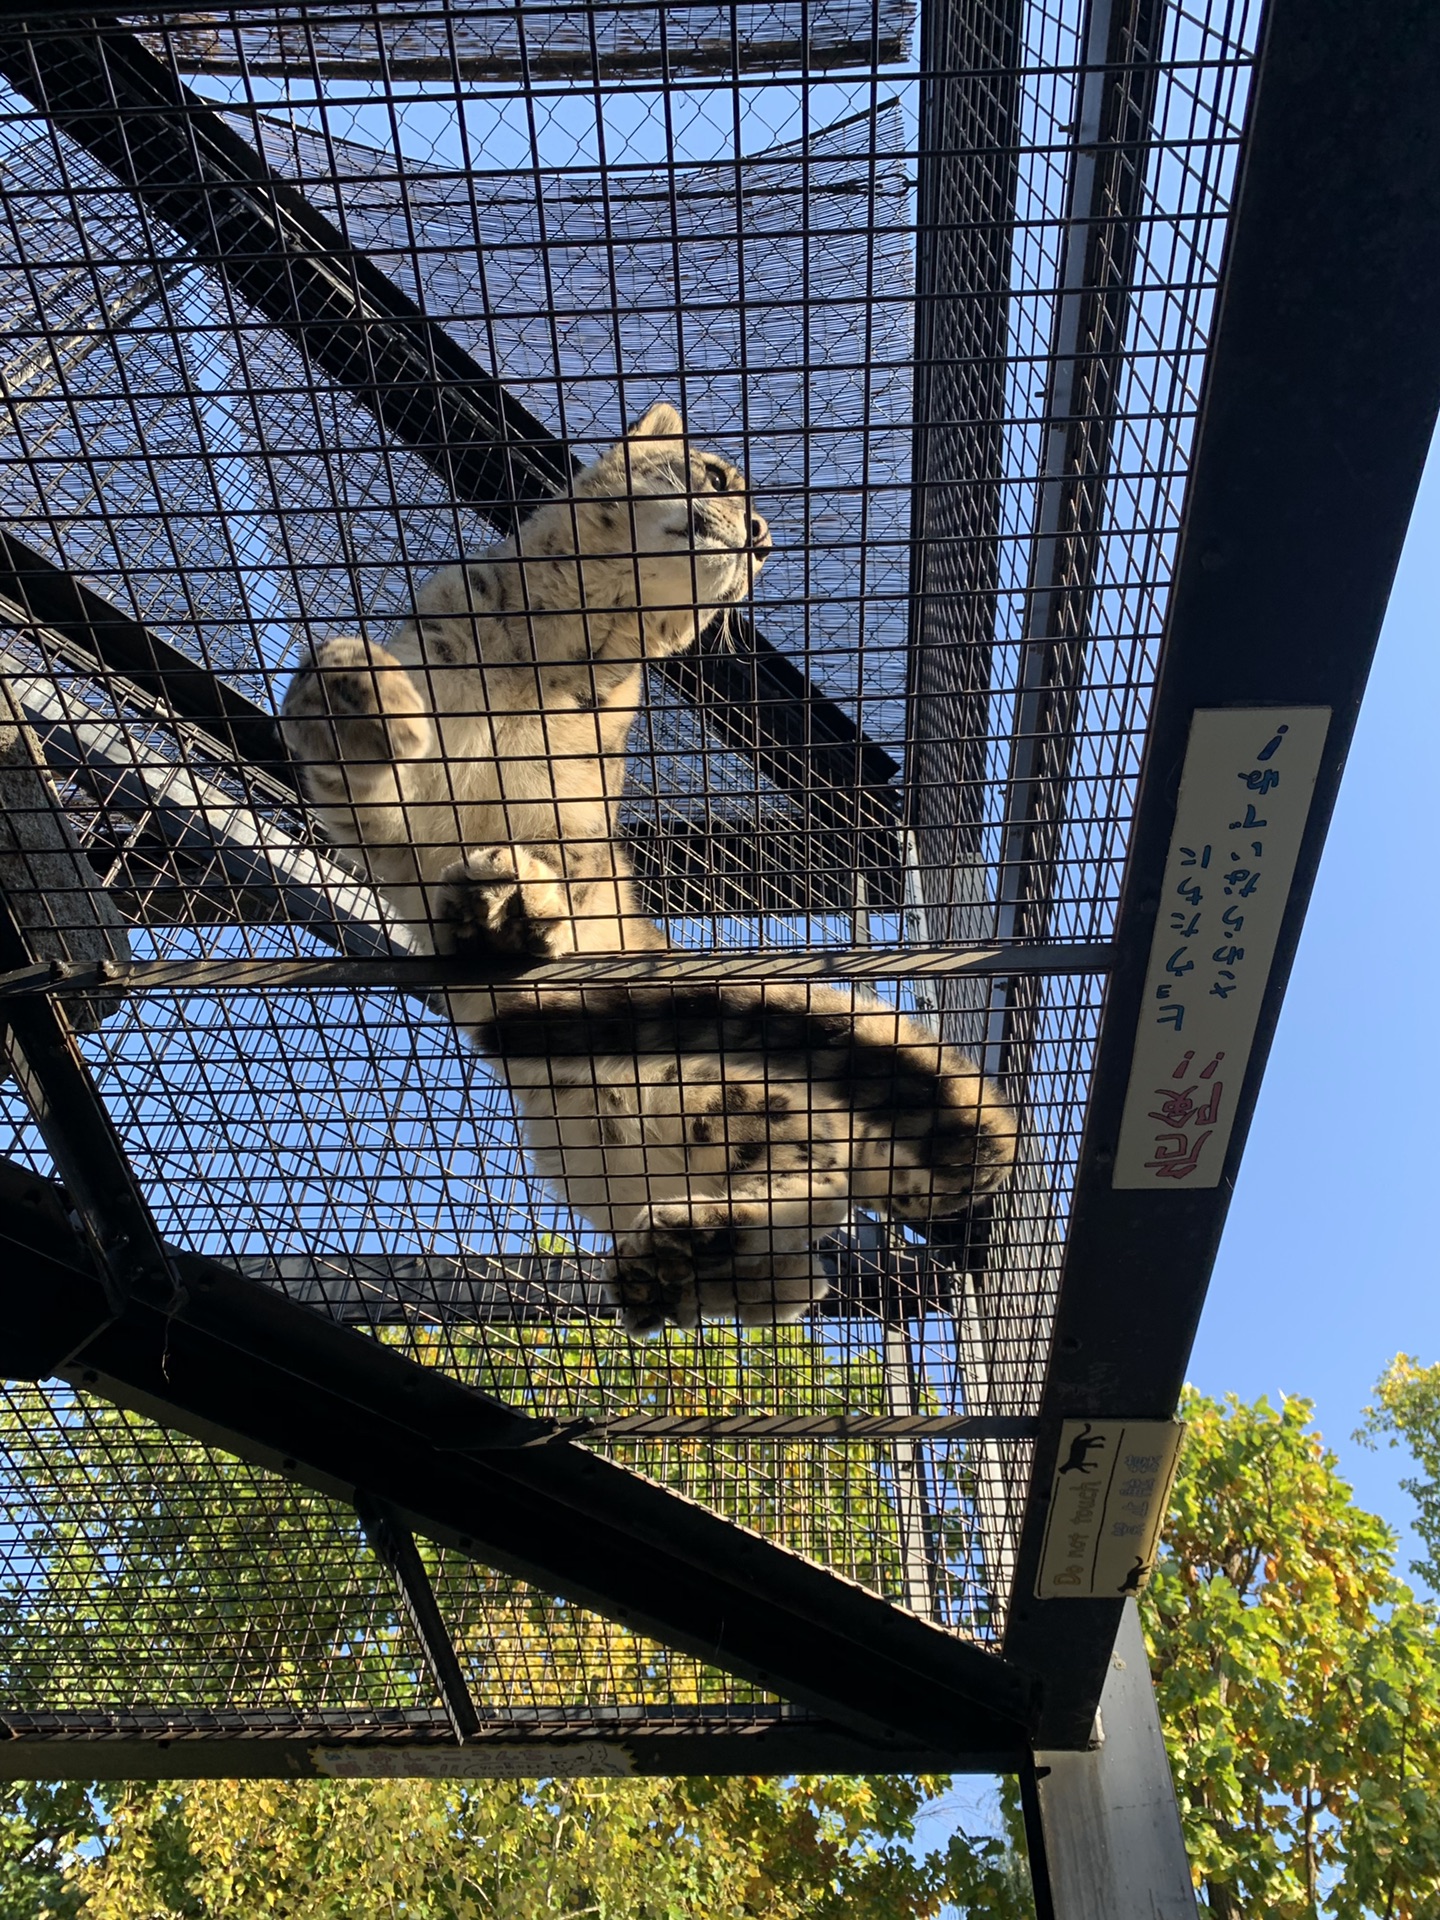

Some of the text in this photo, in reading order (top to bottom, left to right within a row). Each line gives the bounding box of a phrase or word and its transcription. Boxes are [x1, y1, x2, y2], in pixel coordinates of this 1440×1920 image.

[1156, 845, 1212, 1031] ヒョウたちに
[1209, 724, 1289, 999] さわらないでね!
[1053, 1481, 1102, 1587] Do not touch
